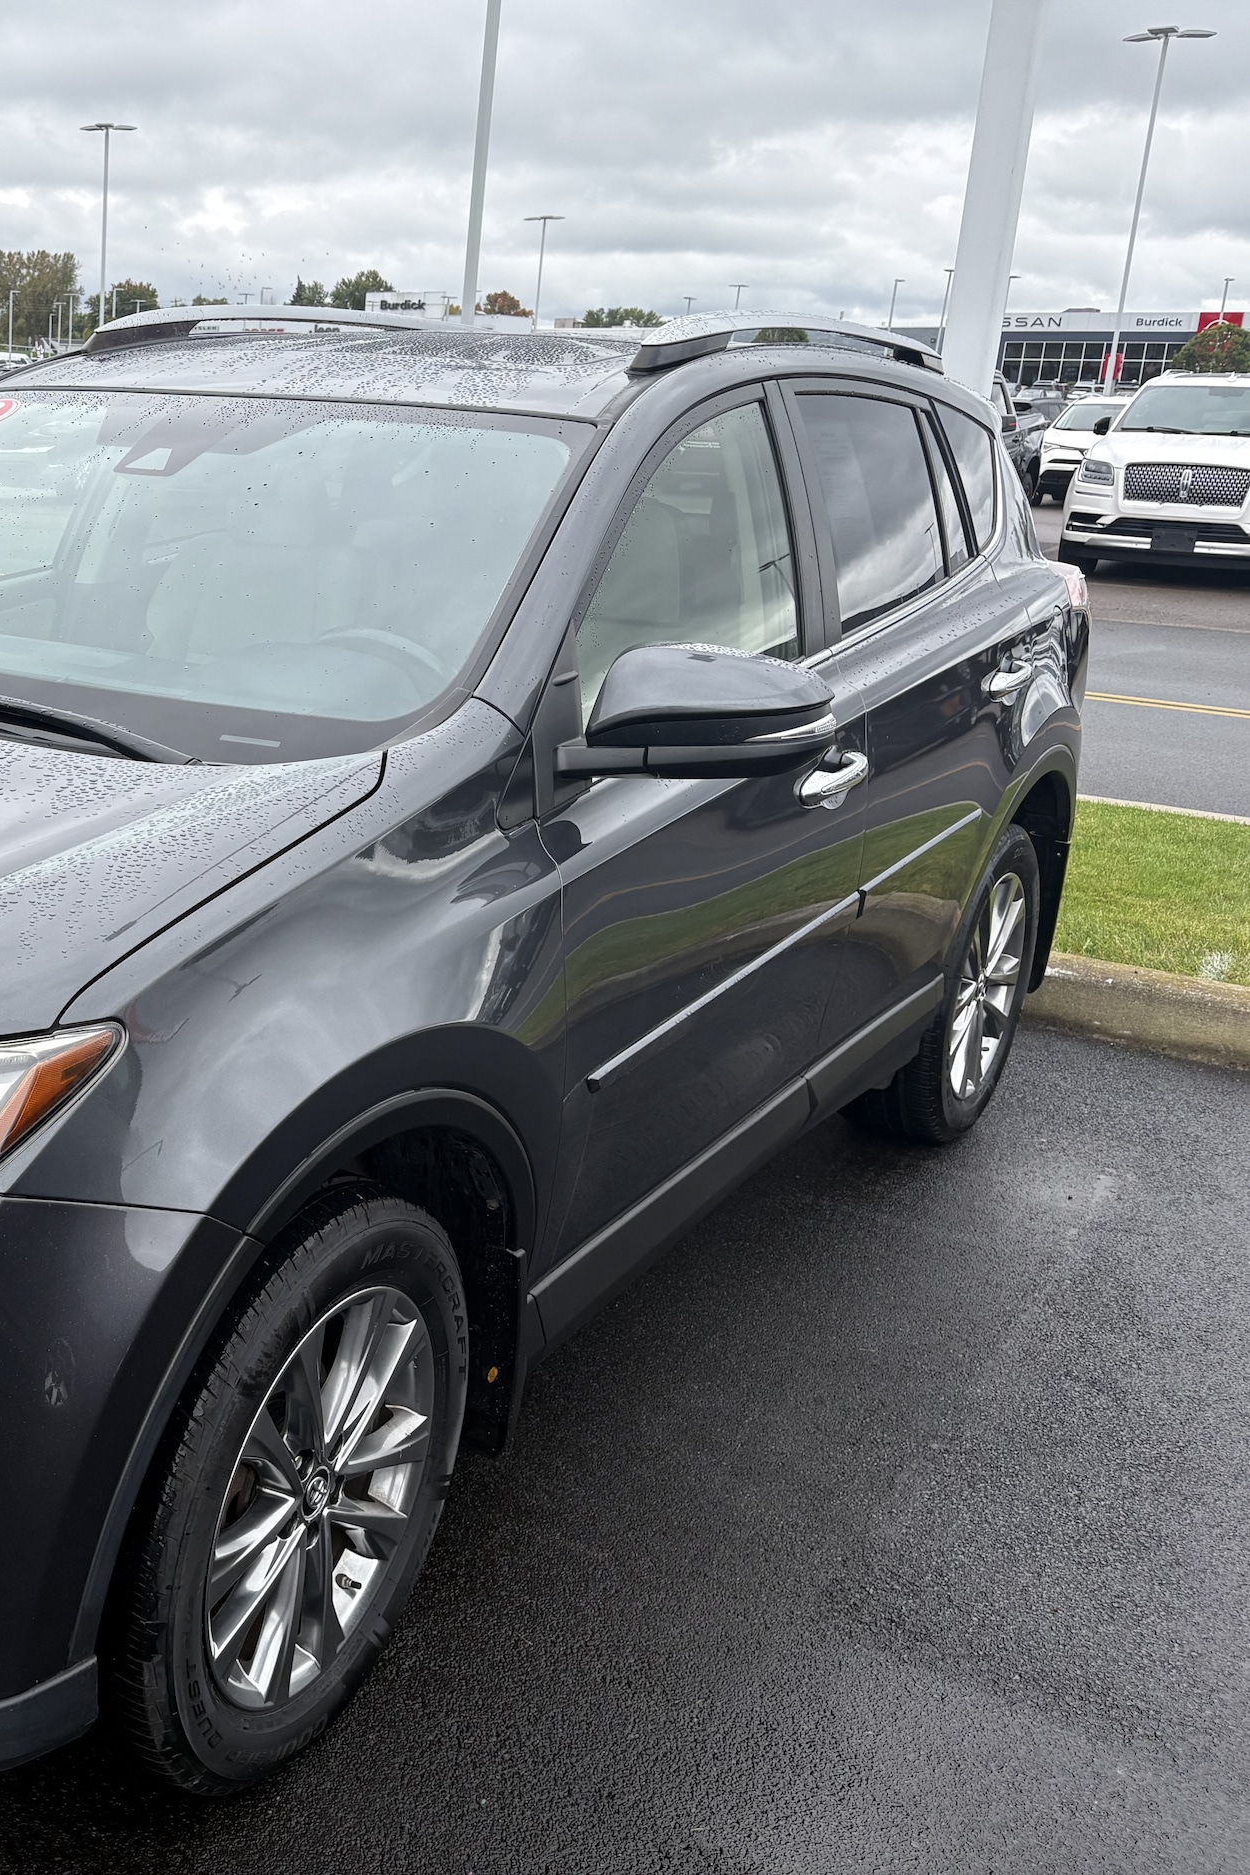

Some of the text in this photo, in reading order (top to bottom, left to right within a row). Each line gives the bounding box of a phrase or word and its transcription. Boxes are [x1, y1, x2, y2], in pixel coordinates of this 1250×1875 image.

[380, 299, 426, 311] Burdick
[1002, 316, 1183, 328] SSAN Burdick
[186, 1658, 223, 1750] QUEST
